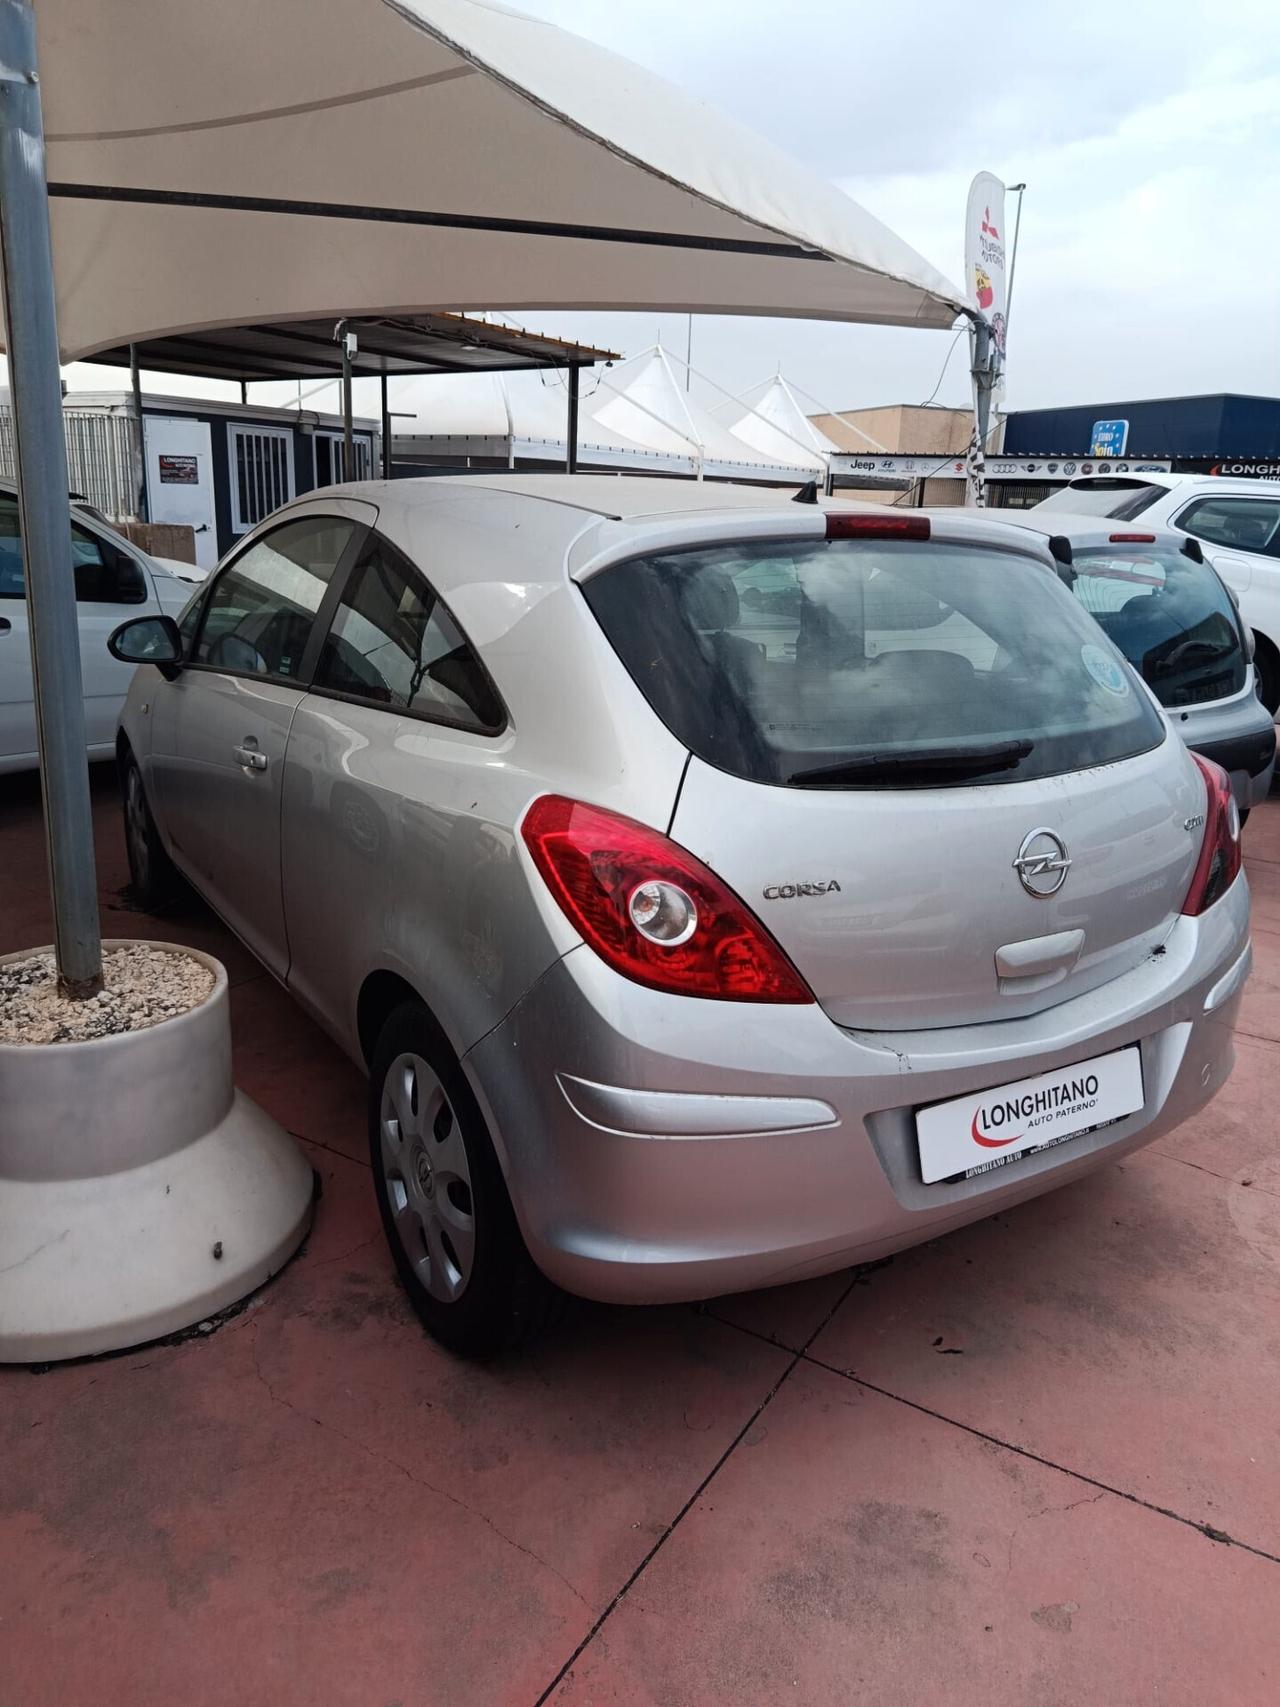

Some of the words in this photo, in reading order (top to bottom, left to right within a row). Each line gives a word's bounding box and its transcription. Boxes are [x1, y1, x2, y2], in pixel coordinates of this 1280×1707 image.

[850, 459, 876, 471] Jeep
[762, 880, 842, 900] CORSA
[981, 1074, 1099, 1130] LONGHITANO
[1027, 1113, 1053, 1129] AUTO
